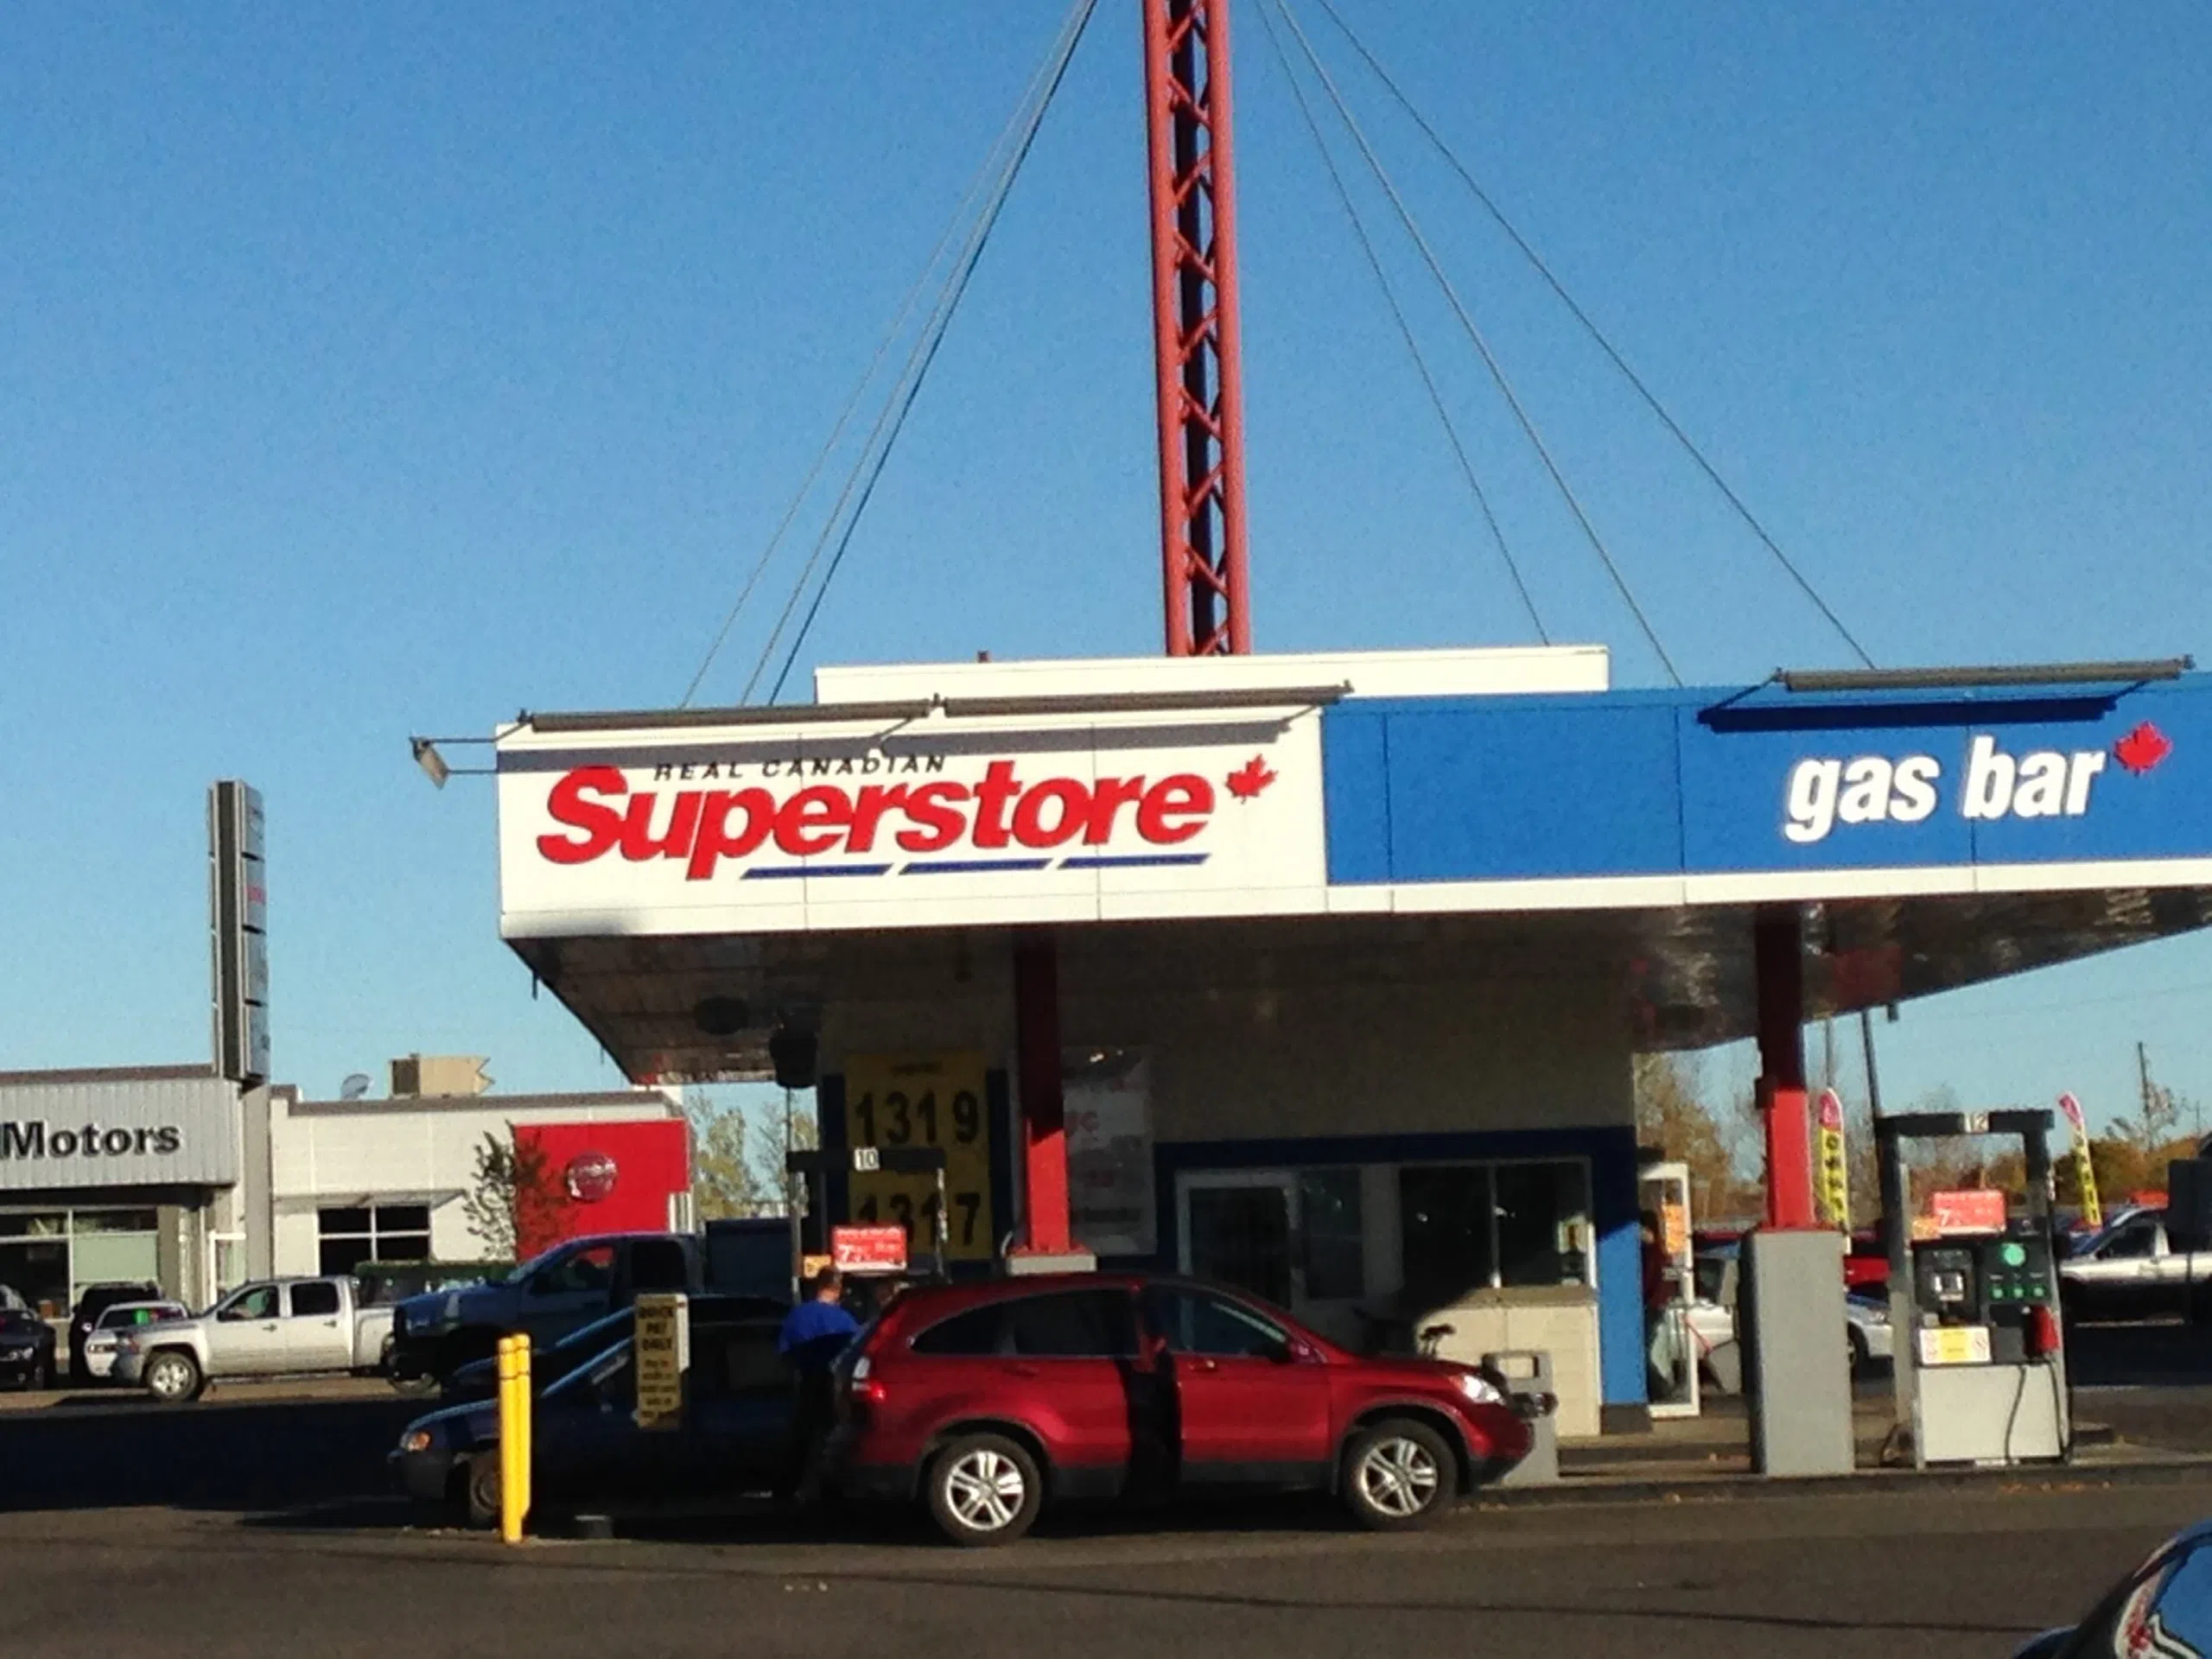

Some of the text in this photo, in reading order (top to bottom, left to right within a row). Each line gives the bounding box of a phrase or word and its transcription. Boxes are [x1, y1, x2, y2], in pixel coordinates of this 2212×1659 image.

[653, 753, 947, 782] REAL CANADIAN
[1784, 735, 2106, 842] gas bar
[538, 762, 1212, 879] Superstore
[0, 1121, 181, 1160] Motors
[857, 1150, 878, 1167] 10
